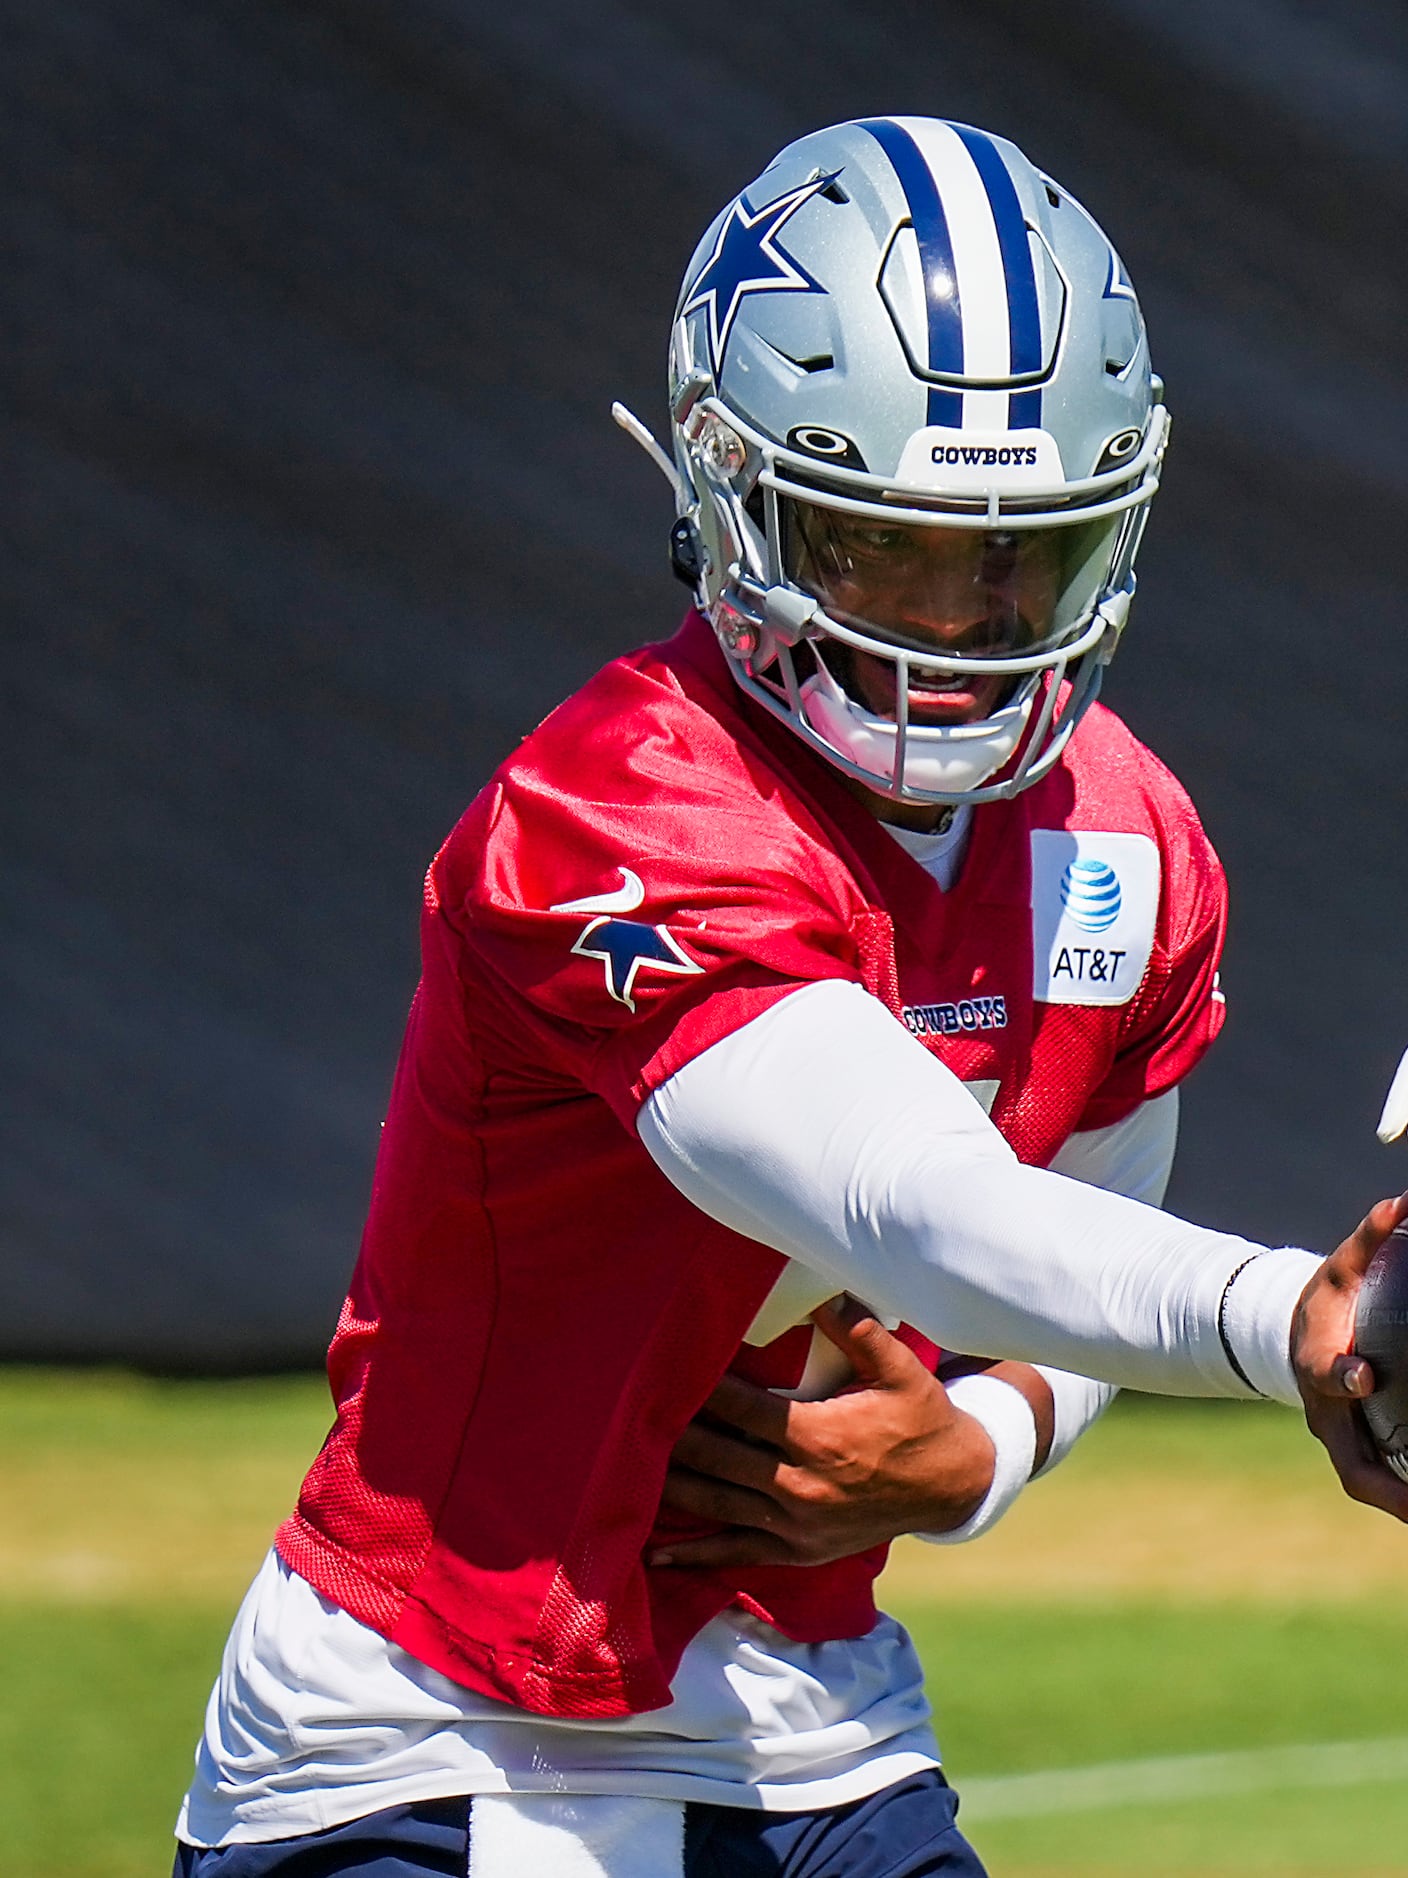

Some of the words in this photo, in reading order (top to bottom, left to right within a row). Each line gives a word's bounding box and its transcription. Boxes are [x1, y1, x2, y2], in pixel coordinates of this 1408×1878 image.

[932, 446, 1037, 465] COWBOYS
[1053, 948, 1126, 982] AT&T
[903, 996, 1007, 1036] COWBOYS
